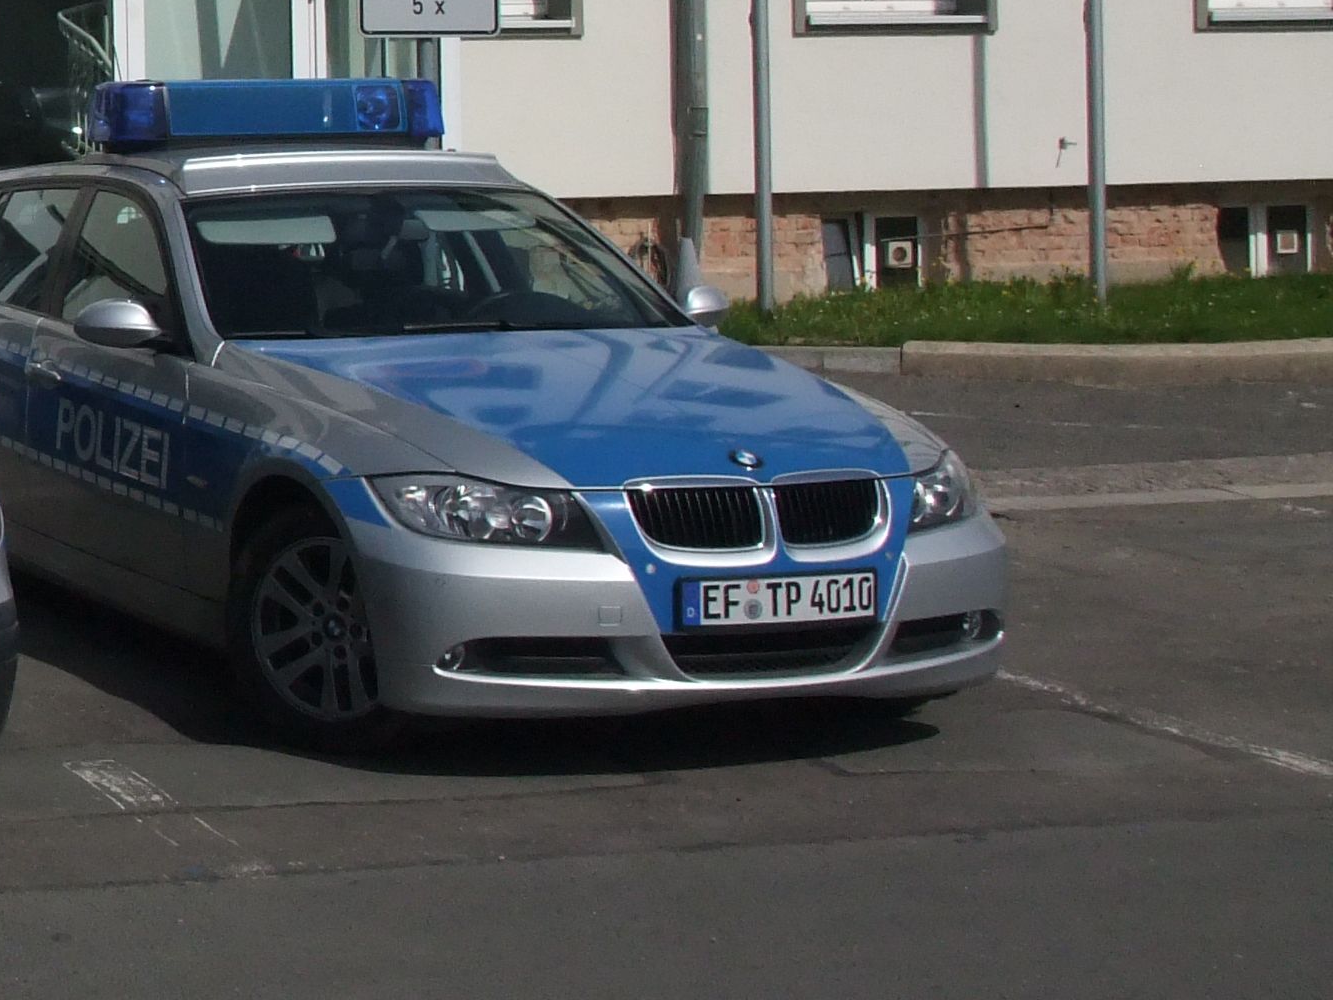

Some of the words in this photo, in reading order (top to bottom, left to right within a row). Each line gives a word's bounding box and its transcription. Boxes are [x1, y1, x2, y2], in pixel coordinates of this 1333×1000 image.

[435, 0, 445, 15] x
[55, 396, 170, 489] POLIZEI
[703, 584, 741, 619] EF
[766, 580, 802, 616] TP
[810, 576, 874, 615] 4010
